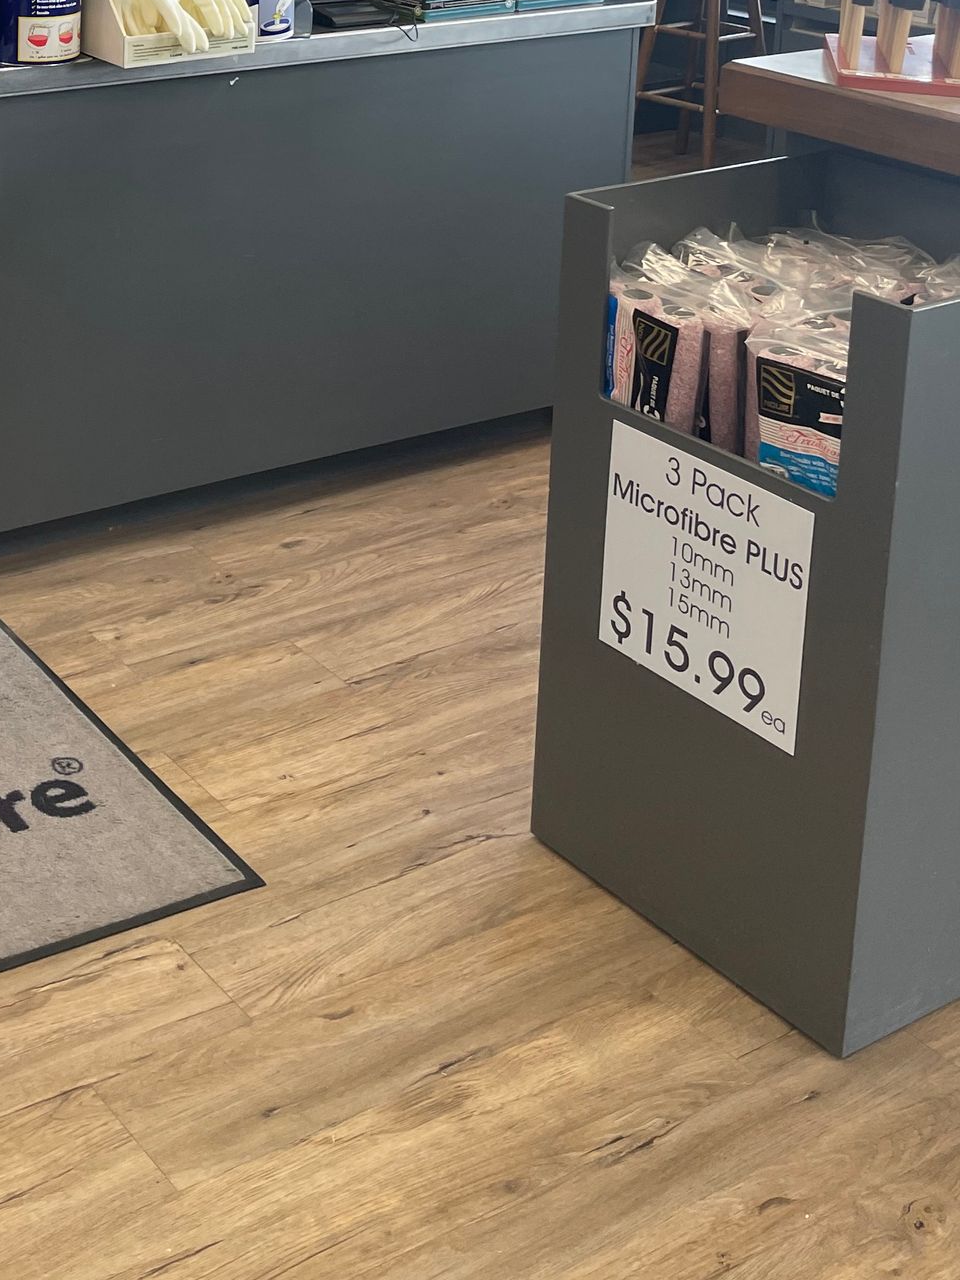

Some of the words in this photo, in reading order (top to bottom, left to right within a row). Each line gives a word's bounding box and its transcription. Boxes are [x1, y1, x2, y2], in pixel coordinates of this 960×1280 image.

[651, 375, 659, 400] PAQUET
[807, 383, 831, 398] PAQUET
[831, 392, 840, 400] DE
[666, 457, 680, 486] 3
[692, 468, 760, 526] Pack
[613, 473, 737, 555] Microfibre
[747, 541, 803, 590] PLUS
[673, 537, 734, 586] 10mm
[669, 562, 732, 612] 13mm
[668, 587, 730, 638] 15mm
[610, 591, 765, 713] $15.99
[761, 708, 786, 734] ea
